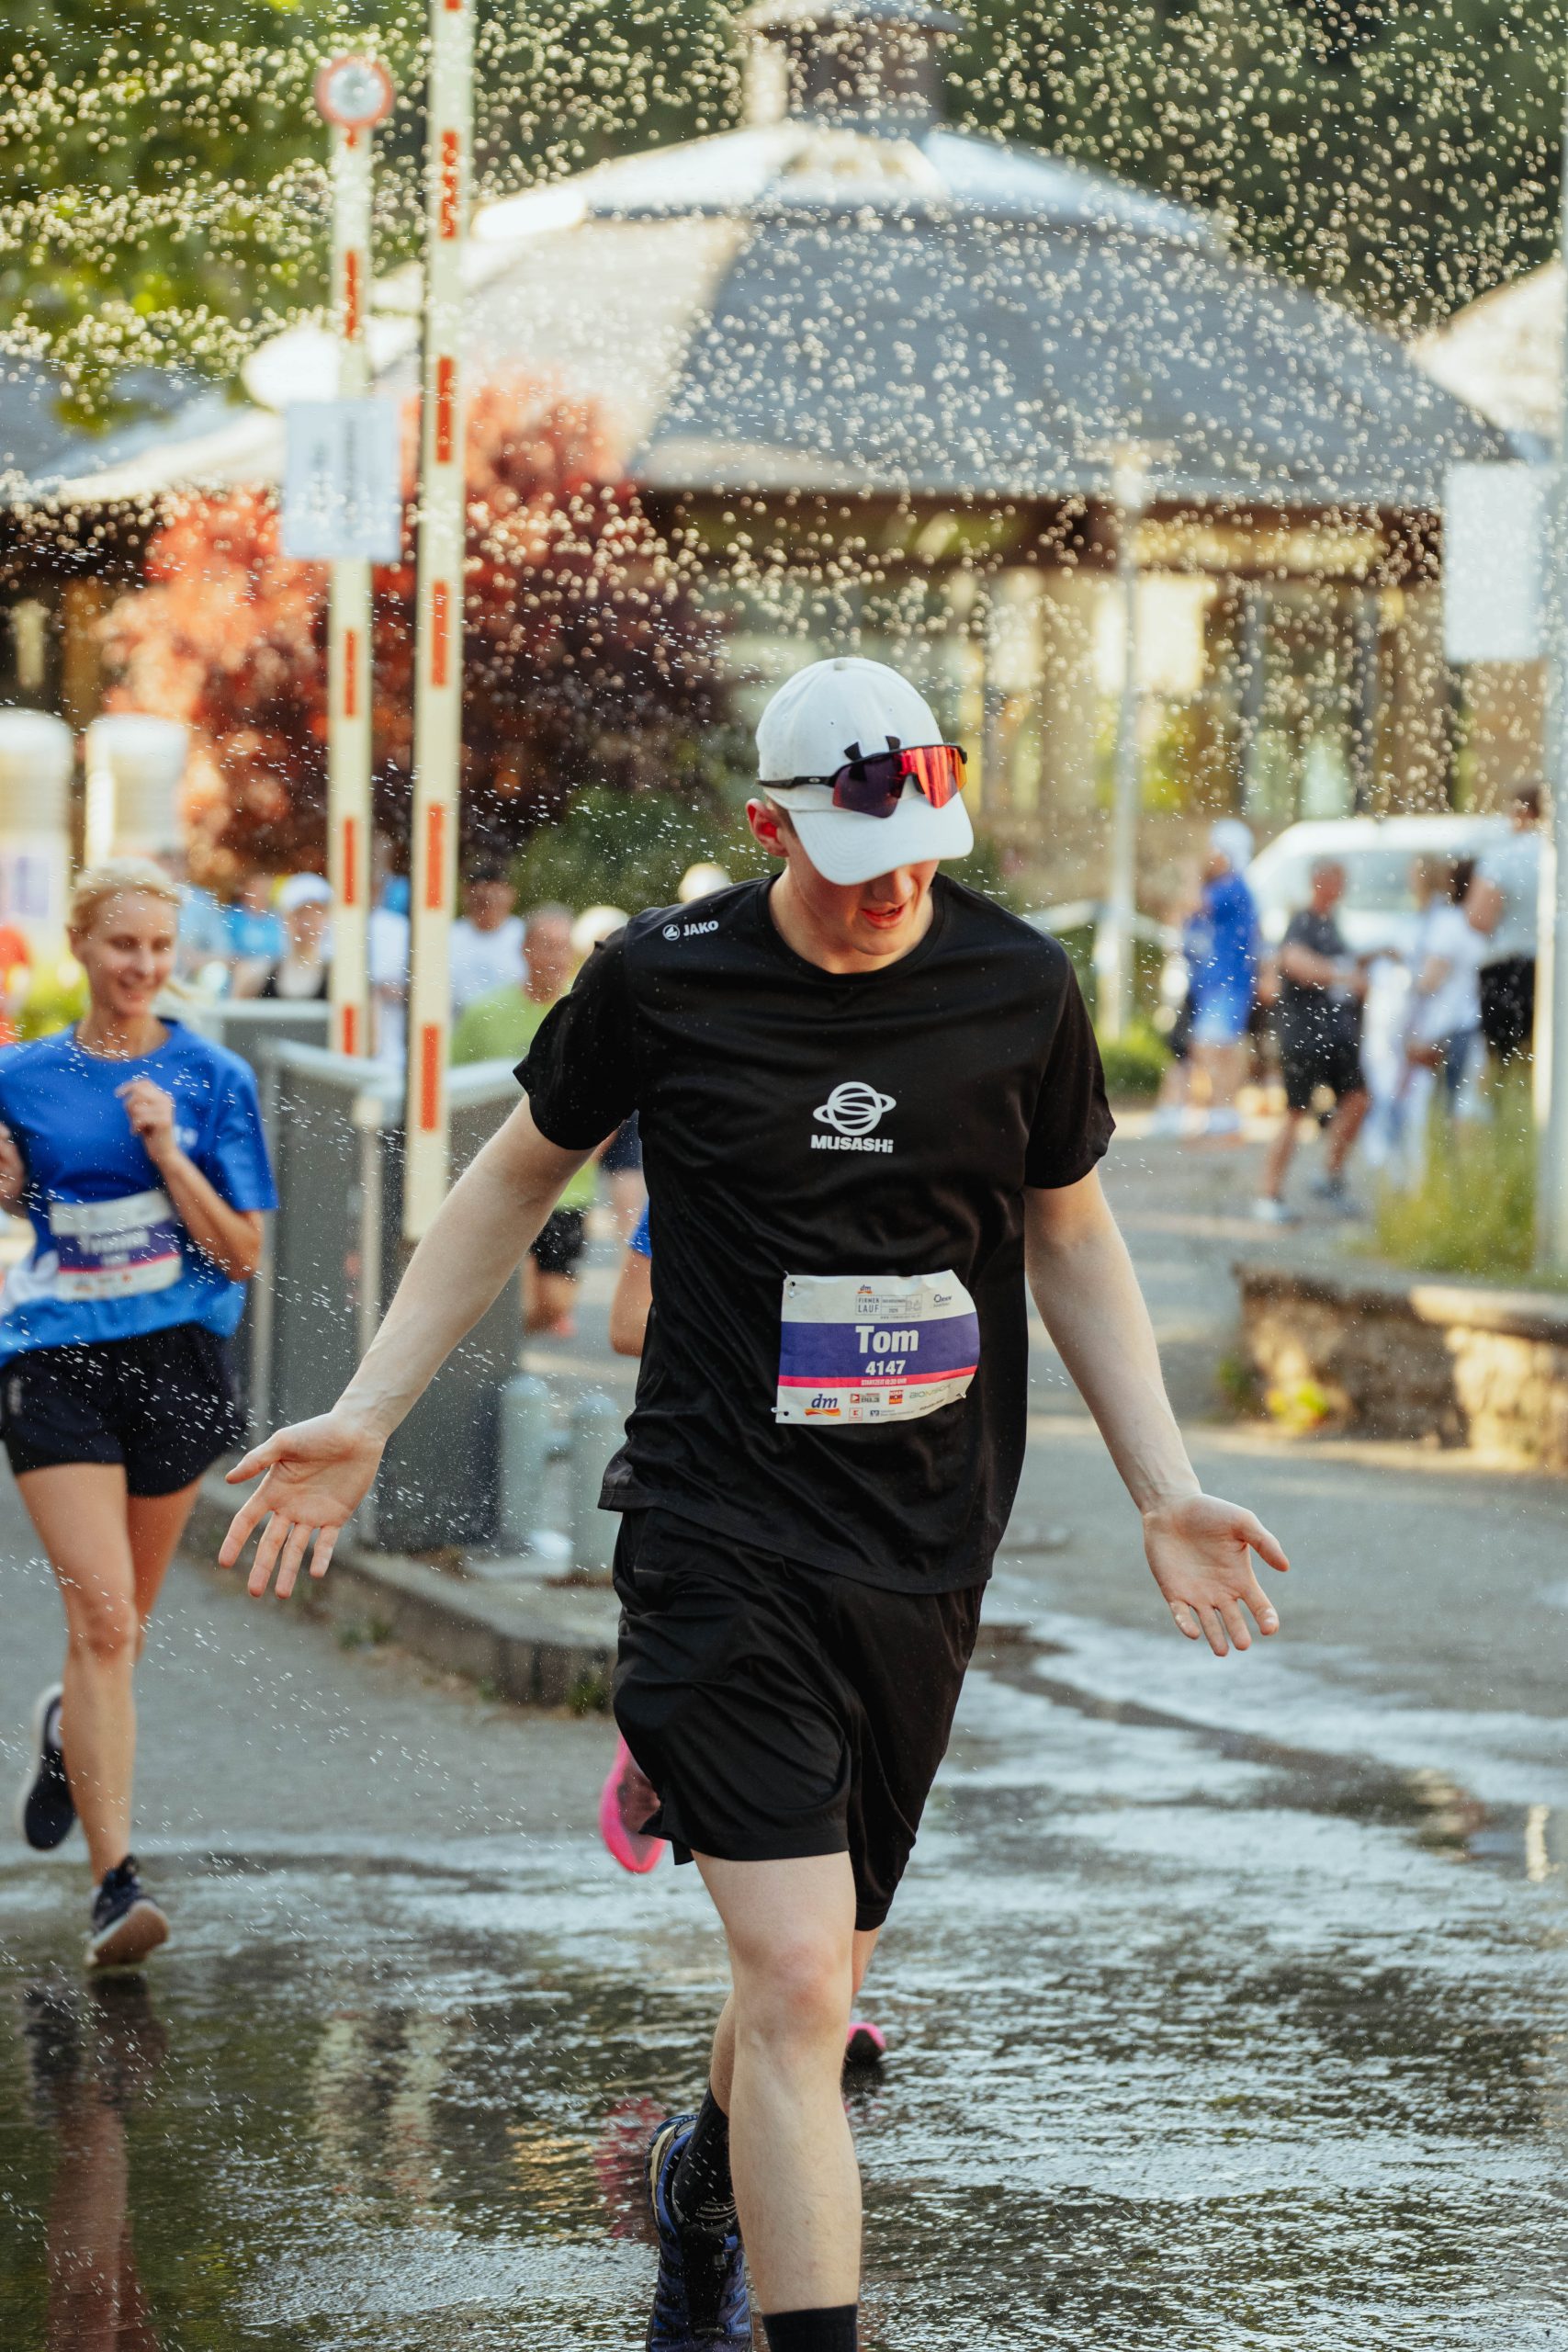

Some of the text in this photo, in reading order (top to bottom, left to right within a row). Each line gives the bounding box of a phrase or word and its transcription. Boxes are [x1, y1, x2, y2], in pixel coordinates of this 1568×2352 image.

[683, 920, 719, 937] JAKO
[858, 1305, 879, 1314] LAUF
[855, 1326, 919, 1353] Tom
[865, 1360, 906, 1376] 4147
[811, 1393, 838, 1409] dm
